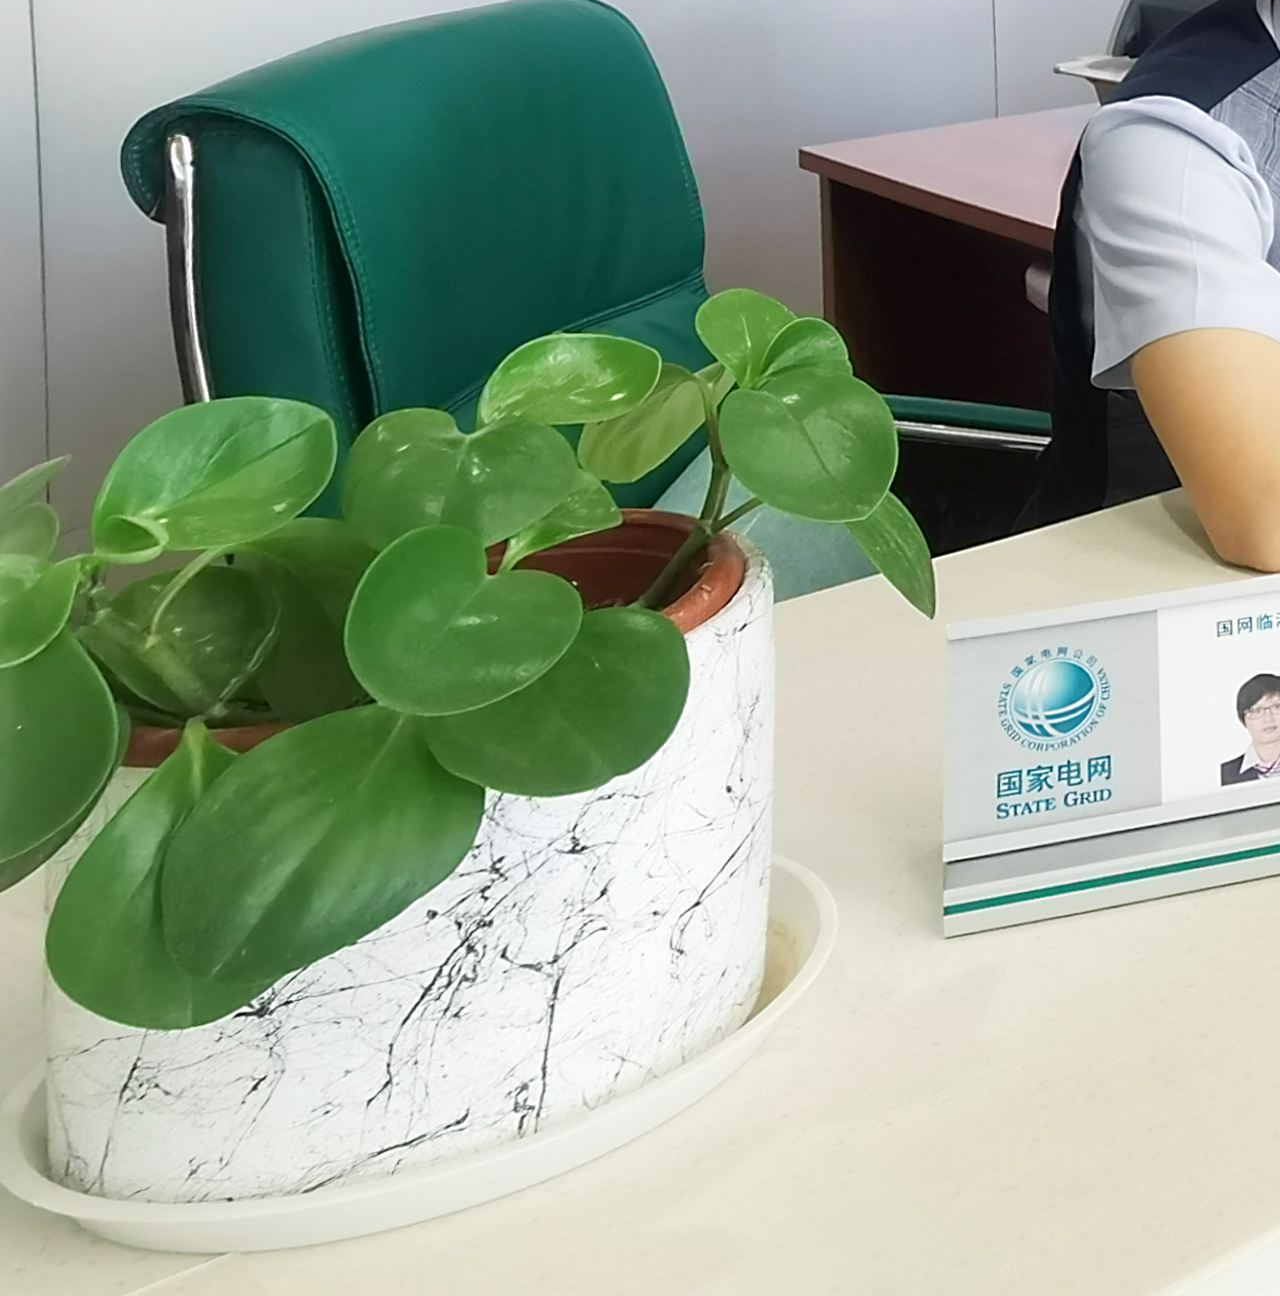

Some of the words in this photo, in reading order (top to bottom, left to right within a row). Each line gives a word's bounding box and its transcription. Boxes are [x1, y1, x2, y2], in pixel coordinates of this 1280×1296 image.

[1010, 646, 1099, 679] 国家电网公司
[998, 682, 1012, 717] STATE
[1096, 667, 1112, 701] CHINA
[1095, 702, 1108, 718] OF
[1000, 720, 1022, 743] GRID
[1020, 718, 1099, 752] CORPORATION
[996, 754, 1112, 799] 国家电网
[996, 797, 1057, 820] STATE
[1063, 788, 1113, 807] GRID
